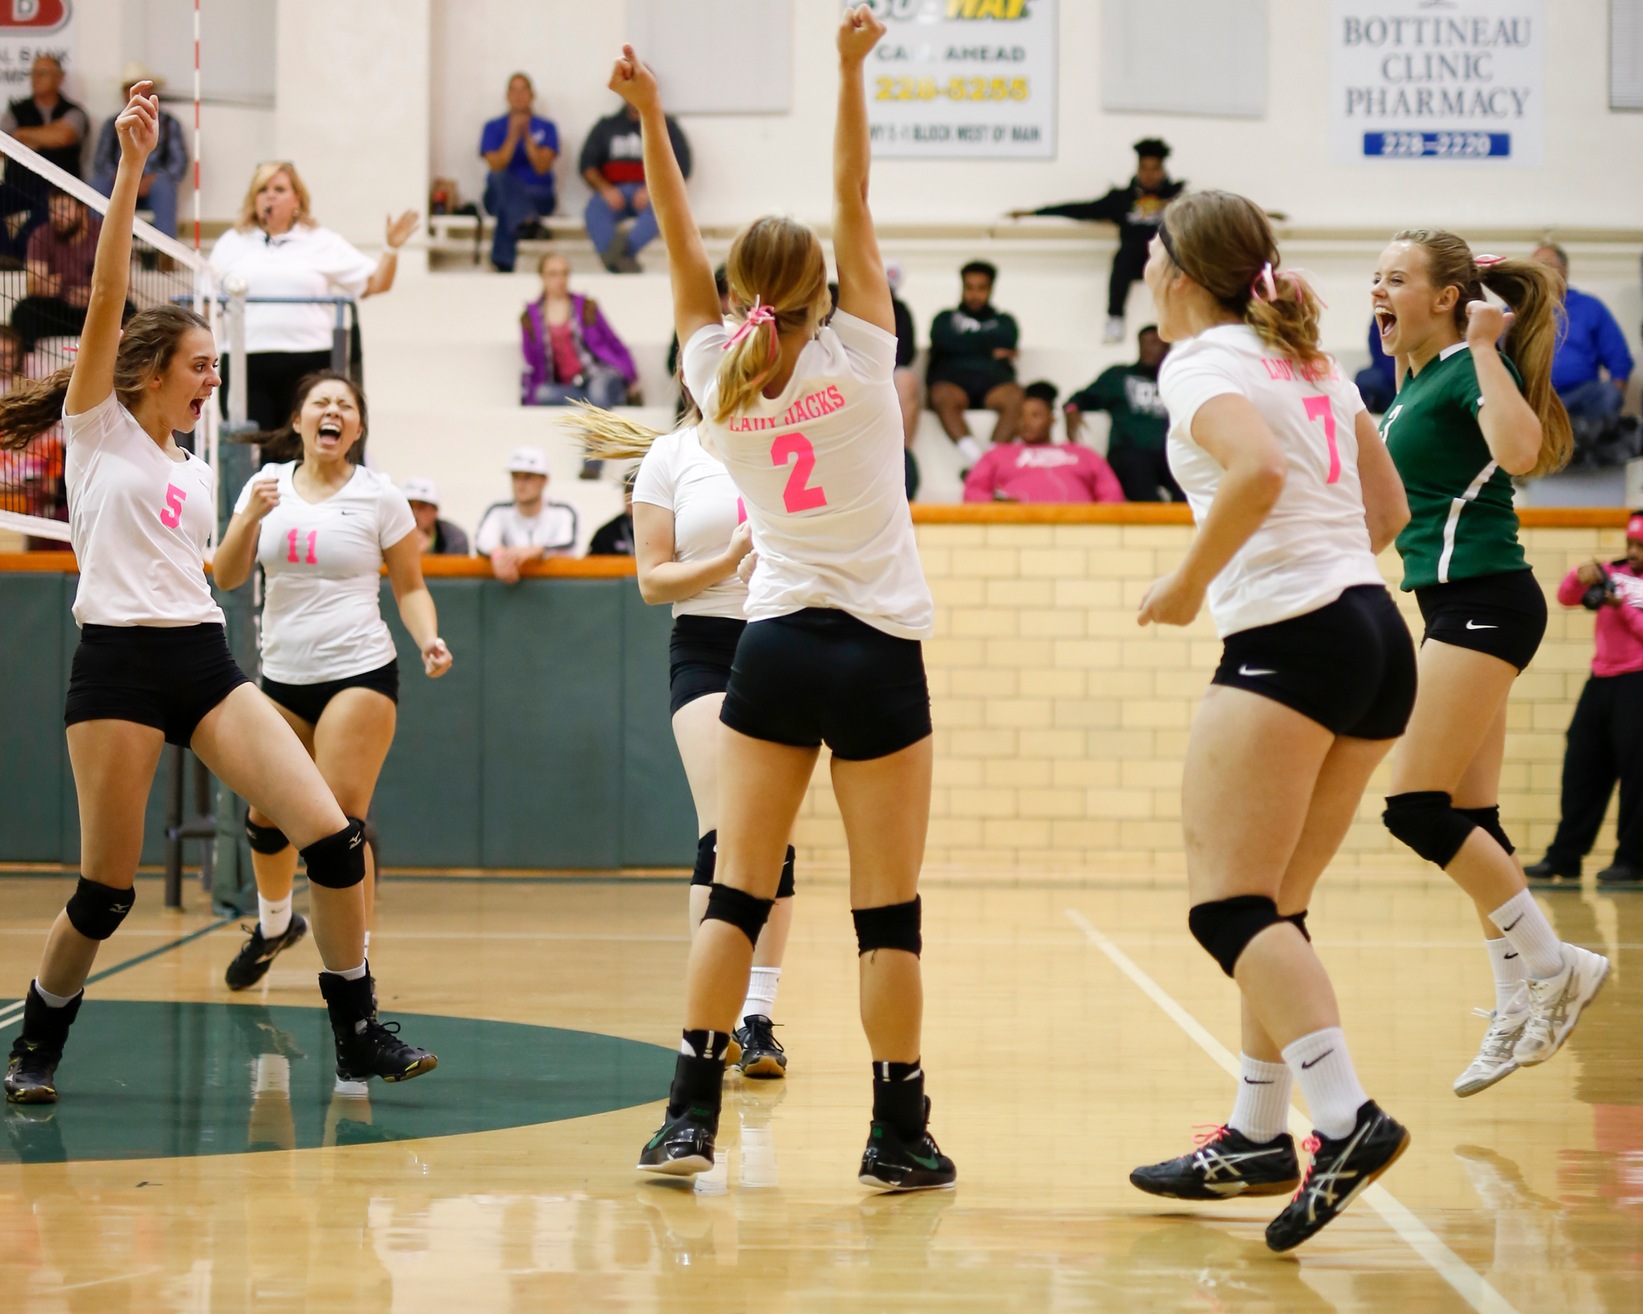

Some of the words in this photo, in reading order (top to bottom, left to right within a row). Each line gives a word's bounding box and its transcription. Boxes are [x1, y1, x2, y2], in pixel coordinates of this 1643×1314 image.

[1343, 16, 1532, 47] BOTTINEAU
[945, 46, 1027, 62] AHEAD
[1380, 52, 1494, 82] CLINIC
[1345, 87, 1531, 117] PHARMACY
[913, 124, 951, 141] BLOCK
[957, 124, 987, 141] WEST
[784, 384, 846, 426] JACKS
[1302, 395, 1341, 485] 7
[770, 432, 828, 514] 2
[160, 483, 187, 530] 5
[287, 528, 319, 565] 11
